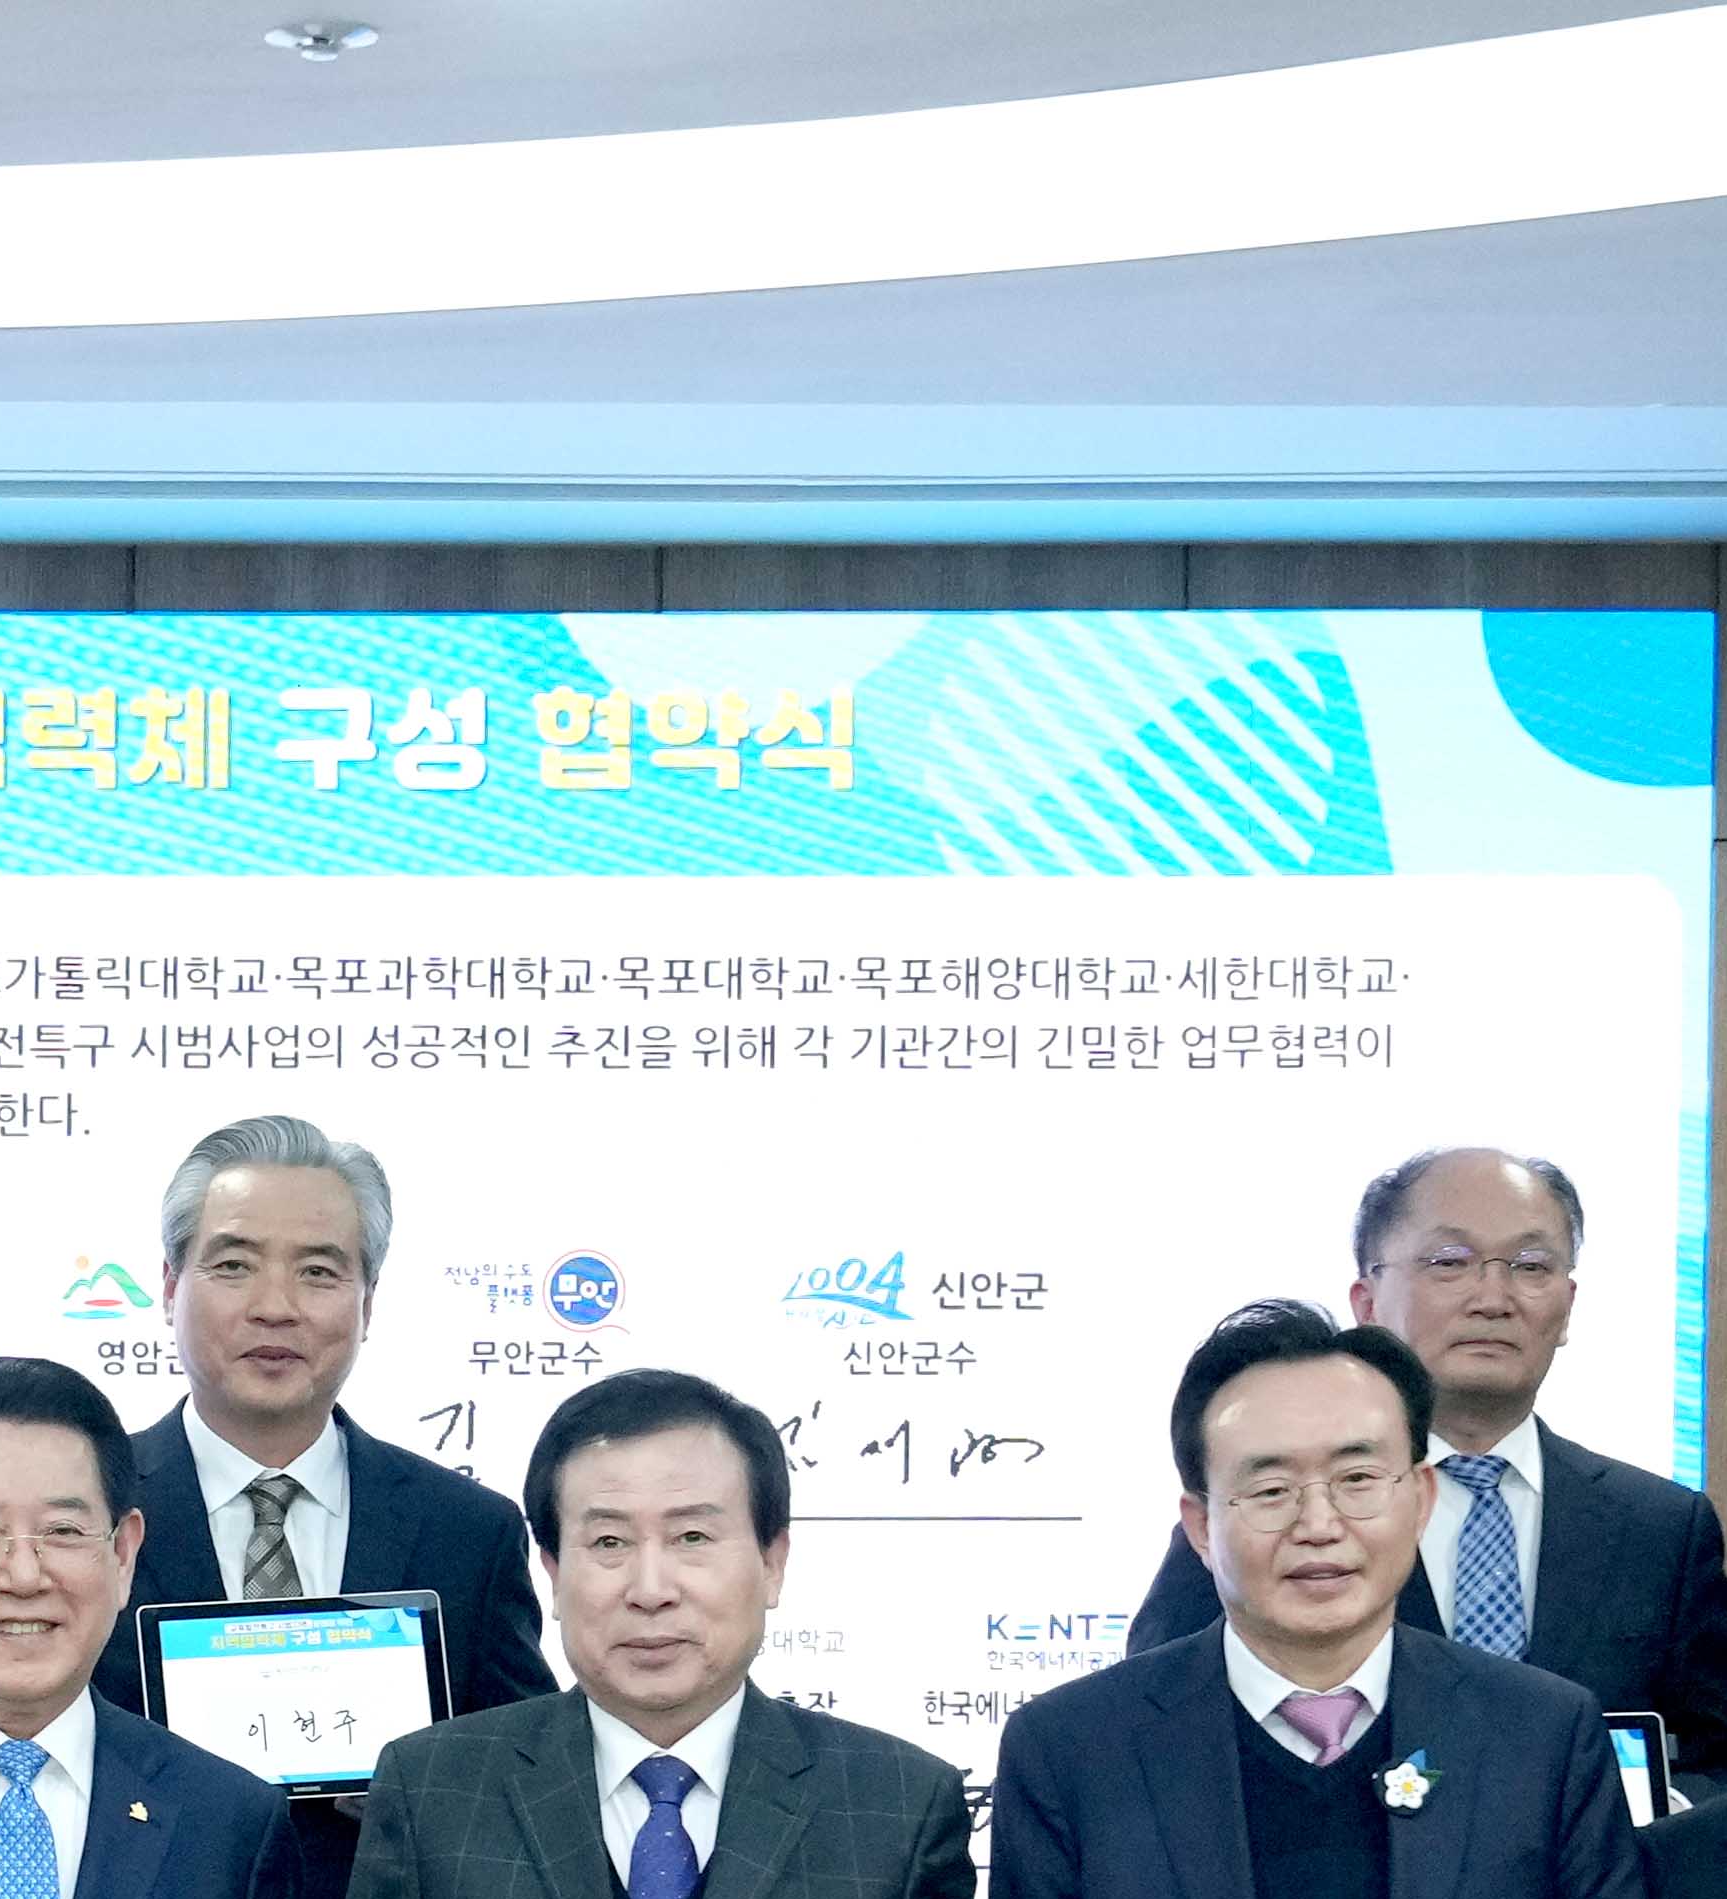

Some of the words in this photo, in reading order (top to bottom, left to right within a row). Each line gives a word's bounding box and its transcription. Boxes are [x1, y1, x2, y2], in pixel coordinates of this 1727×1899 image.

[275, 687, 488, 791] 구성
[533, 686, 856, 791] 협약식
[131, 1024, 342, 1070] 시범사업의
[362, 1024, 530, 1070] 성공적인
[547, 1024, 677, 1070] 추진을
[692, 1024, 776, 1070] 위해
[793, 1025, 834, 1070] 각
[851, 1024, 1017, 1070] 기관간의
[1037, 1025, 1165, 1070] 긴밀한
[1181, 1024, 1391, 1070] 업무협력이
[932, 1271, 1049, 1311] 신안군
[468, 1340, 603, 1375] 무안군수
[843, 1340, 977, 1376] 신안군수
